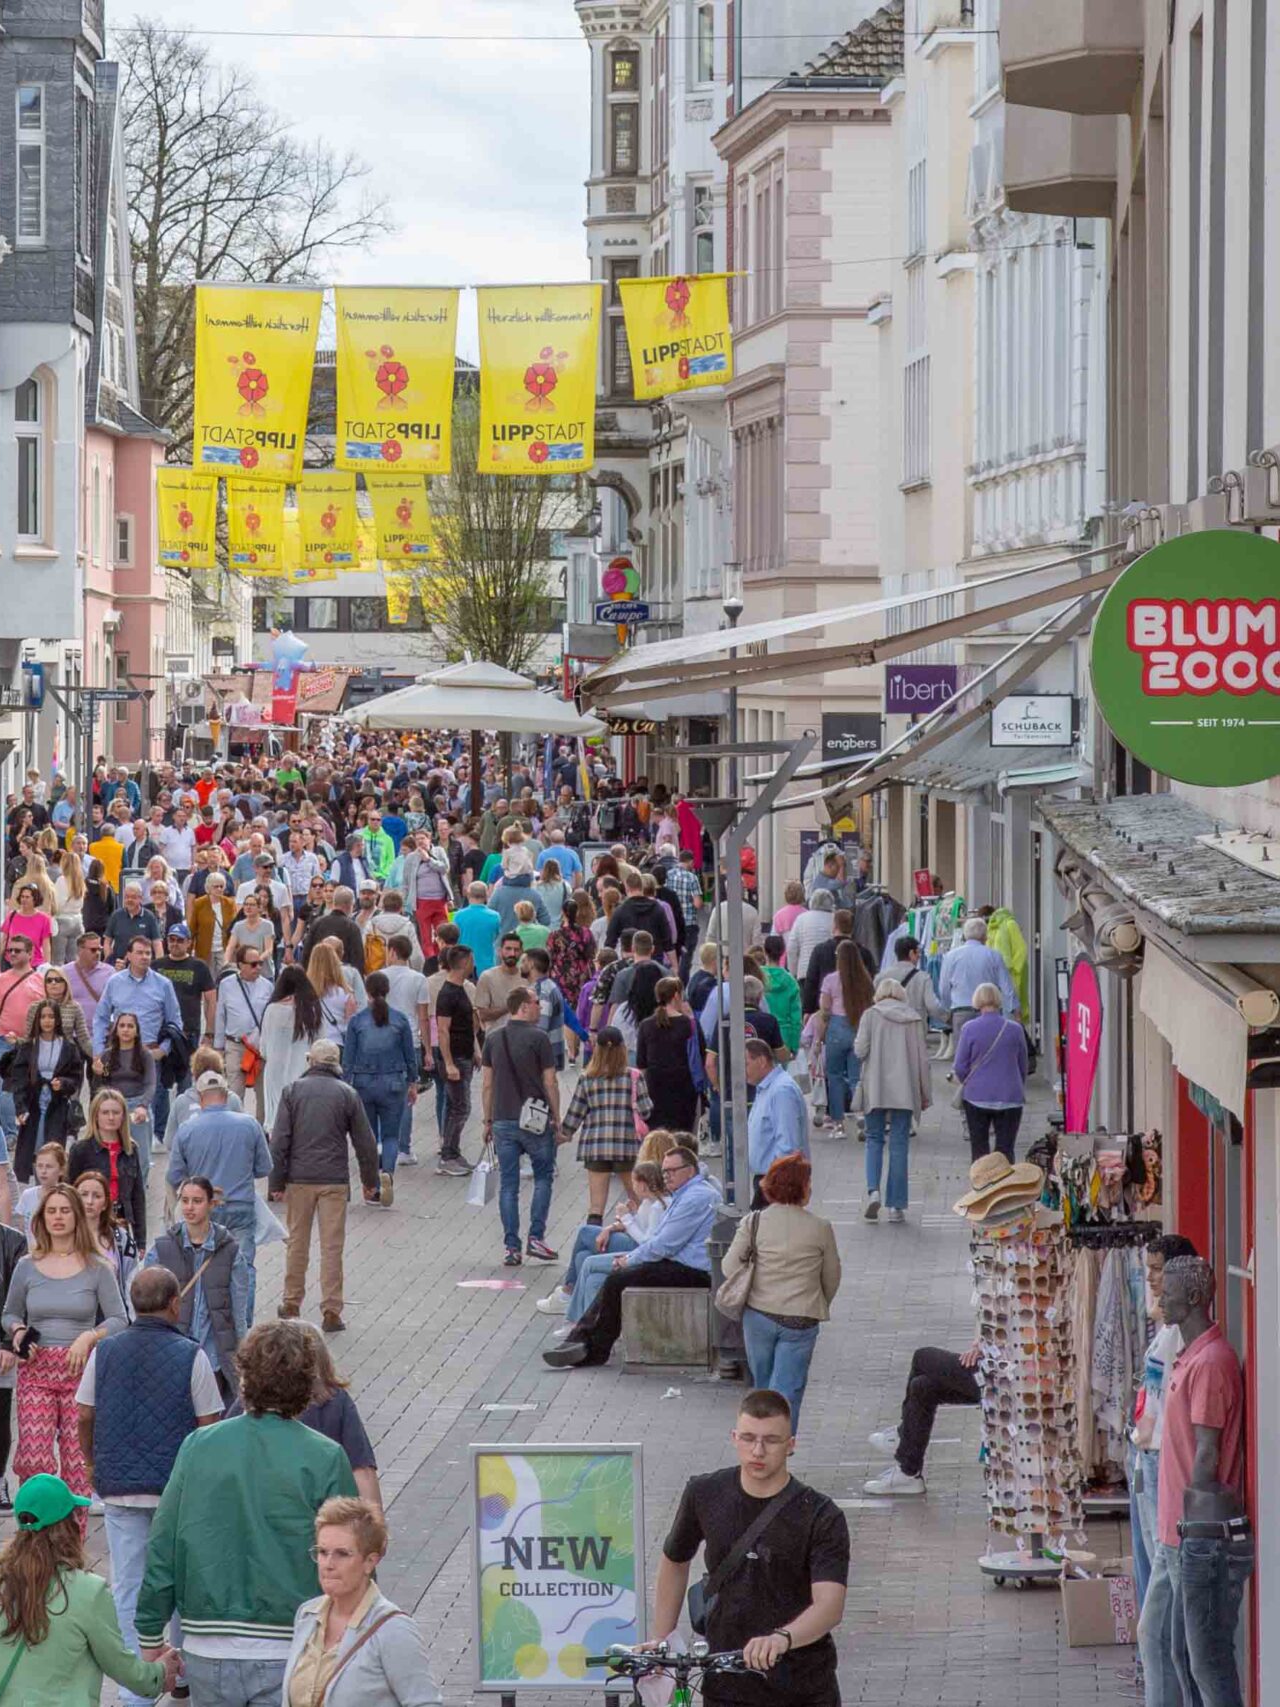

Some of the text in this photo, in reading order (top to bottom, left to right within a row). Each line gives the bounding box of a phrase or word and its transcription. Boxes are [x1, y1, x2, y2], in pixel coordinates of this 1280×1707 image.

[487, 307, 593, 324] Herzlich willkommen!
[643, 331, 725, 366] LIPPSTADT
[492, 421, 587, 441] LIPPSTADT
[1001, 722, 1062, 731] SCHUBACK
[1197, 718, 1245, 728] SEIT 1974
[827, 737, 877, 750] engbers
[501, 1536, 613, 1571] NEW
[500, 1582, 614, 1597] COLLECTION
